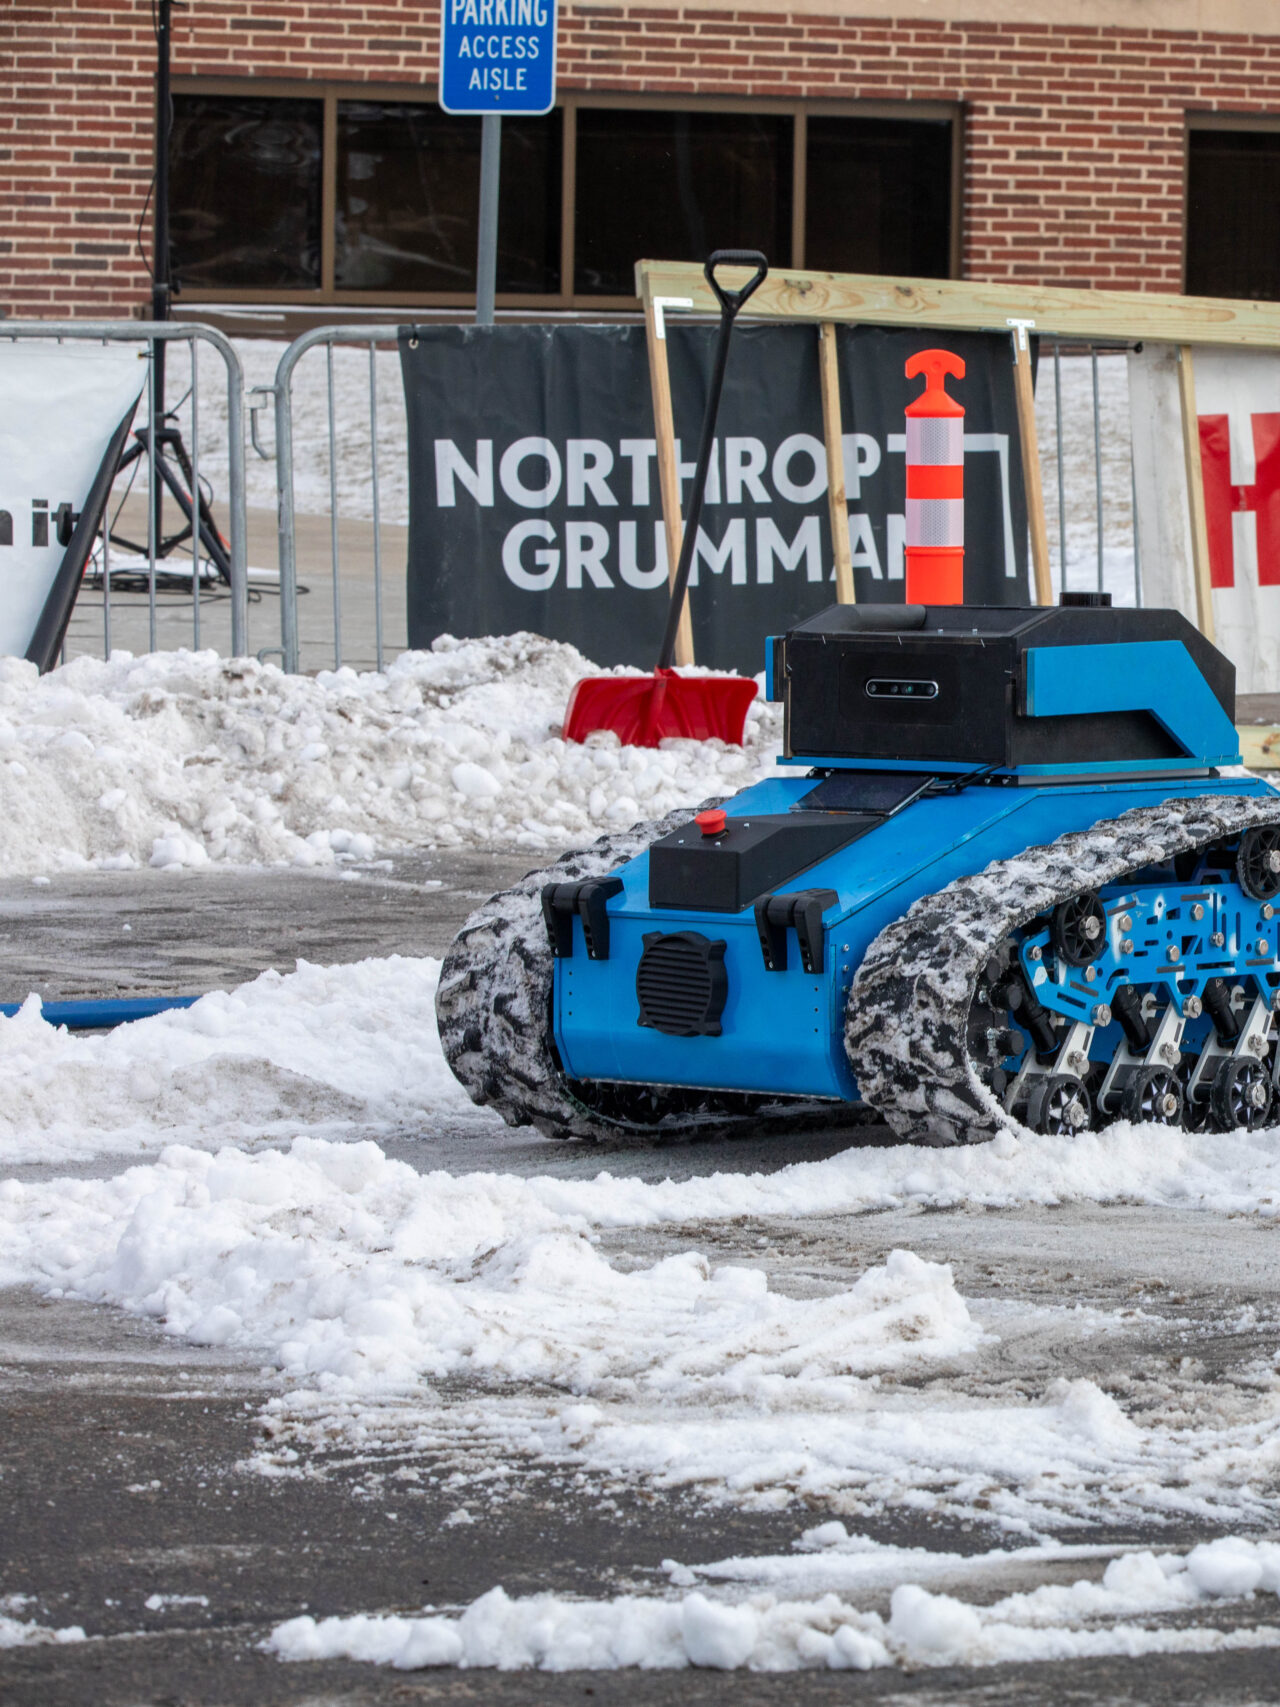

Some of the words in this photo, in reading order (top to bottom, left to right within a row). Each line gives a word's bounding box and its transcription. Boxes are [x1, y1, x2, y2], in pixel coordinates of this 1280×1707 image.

[451, 0, 548, 27] PARKING
[458, 35, 540, 59] ACCESS
[468, 67, 528, 91] AISLE
